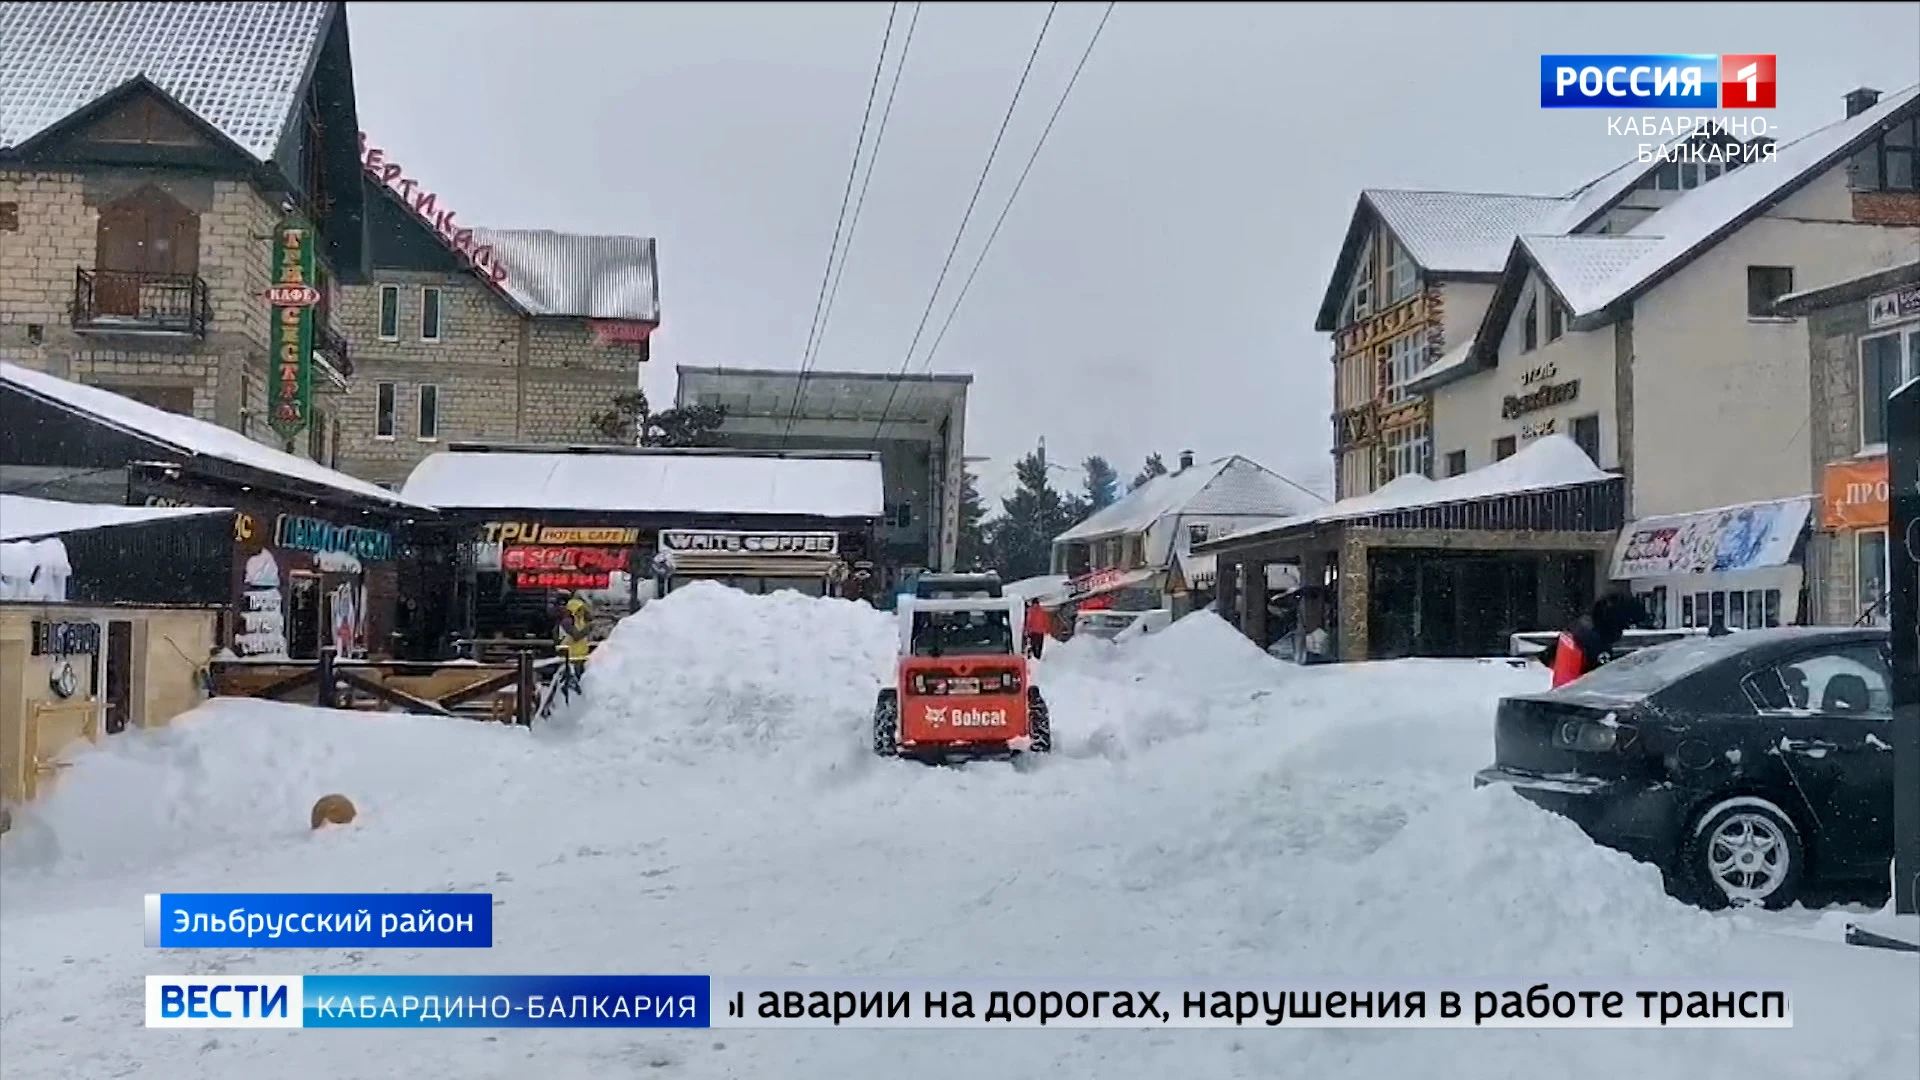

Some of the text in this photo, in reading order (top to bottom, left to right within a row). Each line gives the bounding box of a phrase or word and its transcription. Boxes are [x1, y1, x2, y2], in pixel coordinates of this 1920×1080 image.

[269, 288, 313, 301] КАФЕ
[744, 536, 832, 551] COFFEE
[951, 707, 1007, 727] Bobcat
